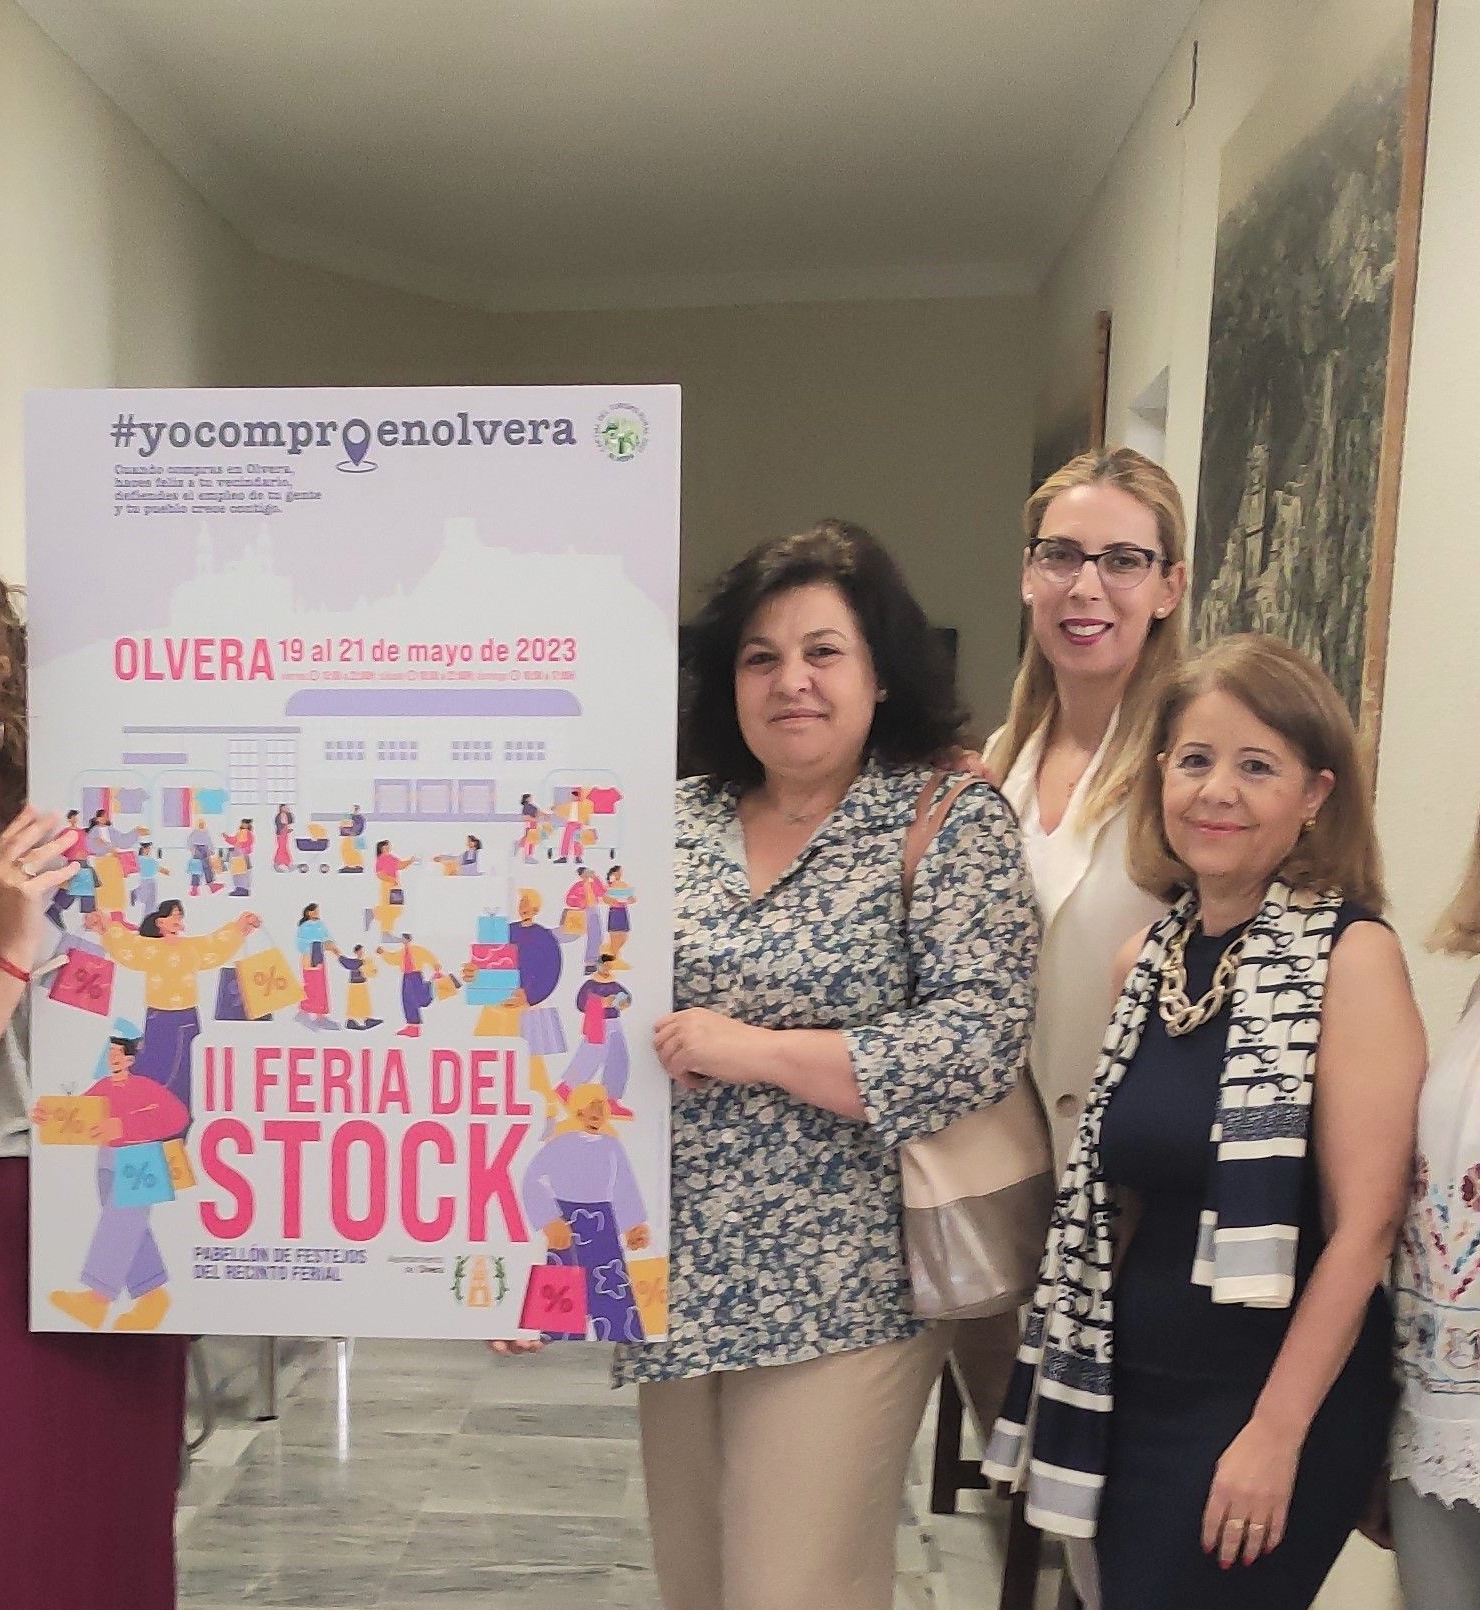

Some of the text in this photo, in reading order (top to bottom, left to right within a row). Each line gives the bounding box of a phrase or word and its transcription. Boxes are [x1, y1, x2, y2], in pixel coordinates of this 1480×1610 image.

[115, 637, 275, 681] OLVERA
[277, 638, 304, 663] 19
[312, 638, 333, 663] al
[339, 638, 365, 663] 21
[371, 638, 401, 663] de
[407, 642, 473, 667] mayo
[480, 638, 510, 663] de
[516, 637, 577, 663] 2023
[203, 1047, 533, 1116] II FERIA DEL
[199, 1117, 531, 1243] STOCK
[194, 1244, 269, 1262] PABELLÓN
[273, 1248, 292, 1263] DE
[296, 1248, 367, 1264] FESTEJOS
[194, 1264, 343, 1282] DEL RECINTO FERIAL
